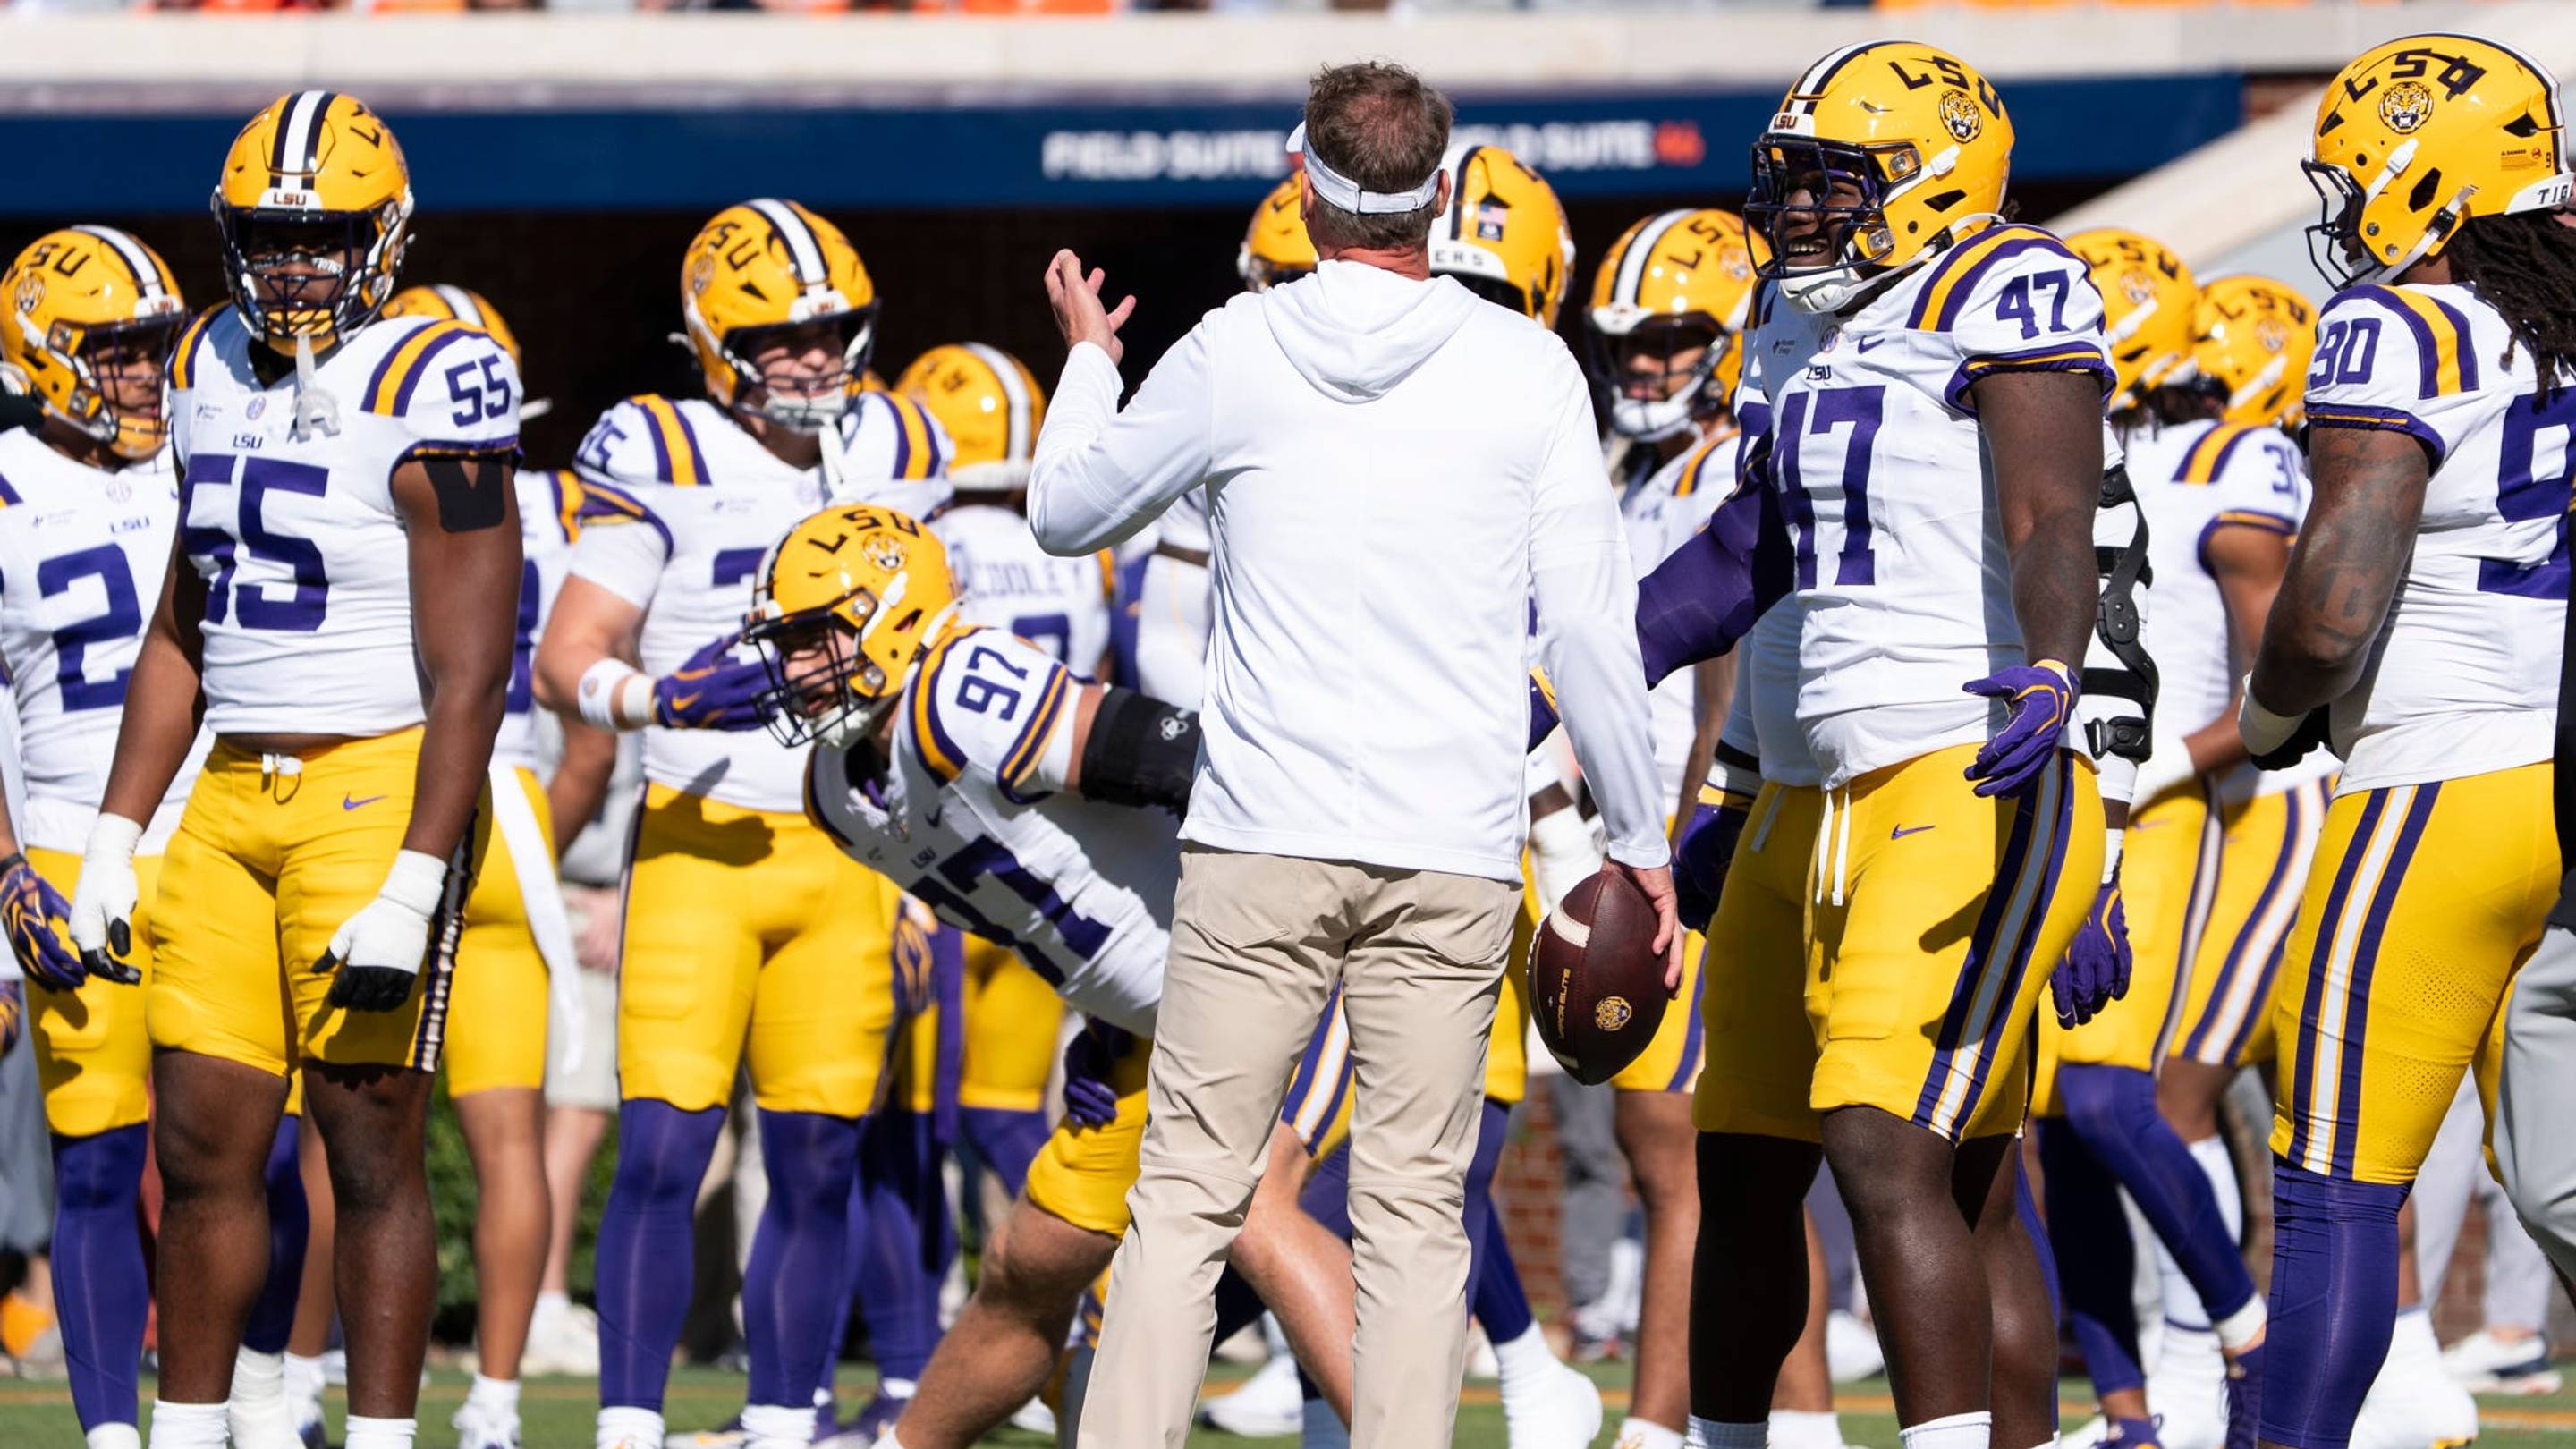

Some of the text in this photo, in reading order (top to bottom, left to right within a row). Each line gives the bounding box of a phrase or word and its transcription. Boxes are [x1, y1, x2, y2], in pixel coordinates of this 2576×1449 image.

[1888, 56, 2000, 119] LSU
[1774, 115, 1798, 129] LSU
[273, 192, 306, 206] LSU
[2538, 184, 2574, 204] TIG
[1435, 250, 1484, 267] ERS
[1996, 269, 2070, 340] 47
[1806, 365, 1832, 380] LSU
[2308, 318, 2382, 390] 90
[445, 354, 510, 428] 55
[233, 433, 263, 449] LSU
[179, 454, 329, 632] 55
[808, 509, 920, 554] LSU
[956, 646, 1029, 721] 97
